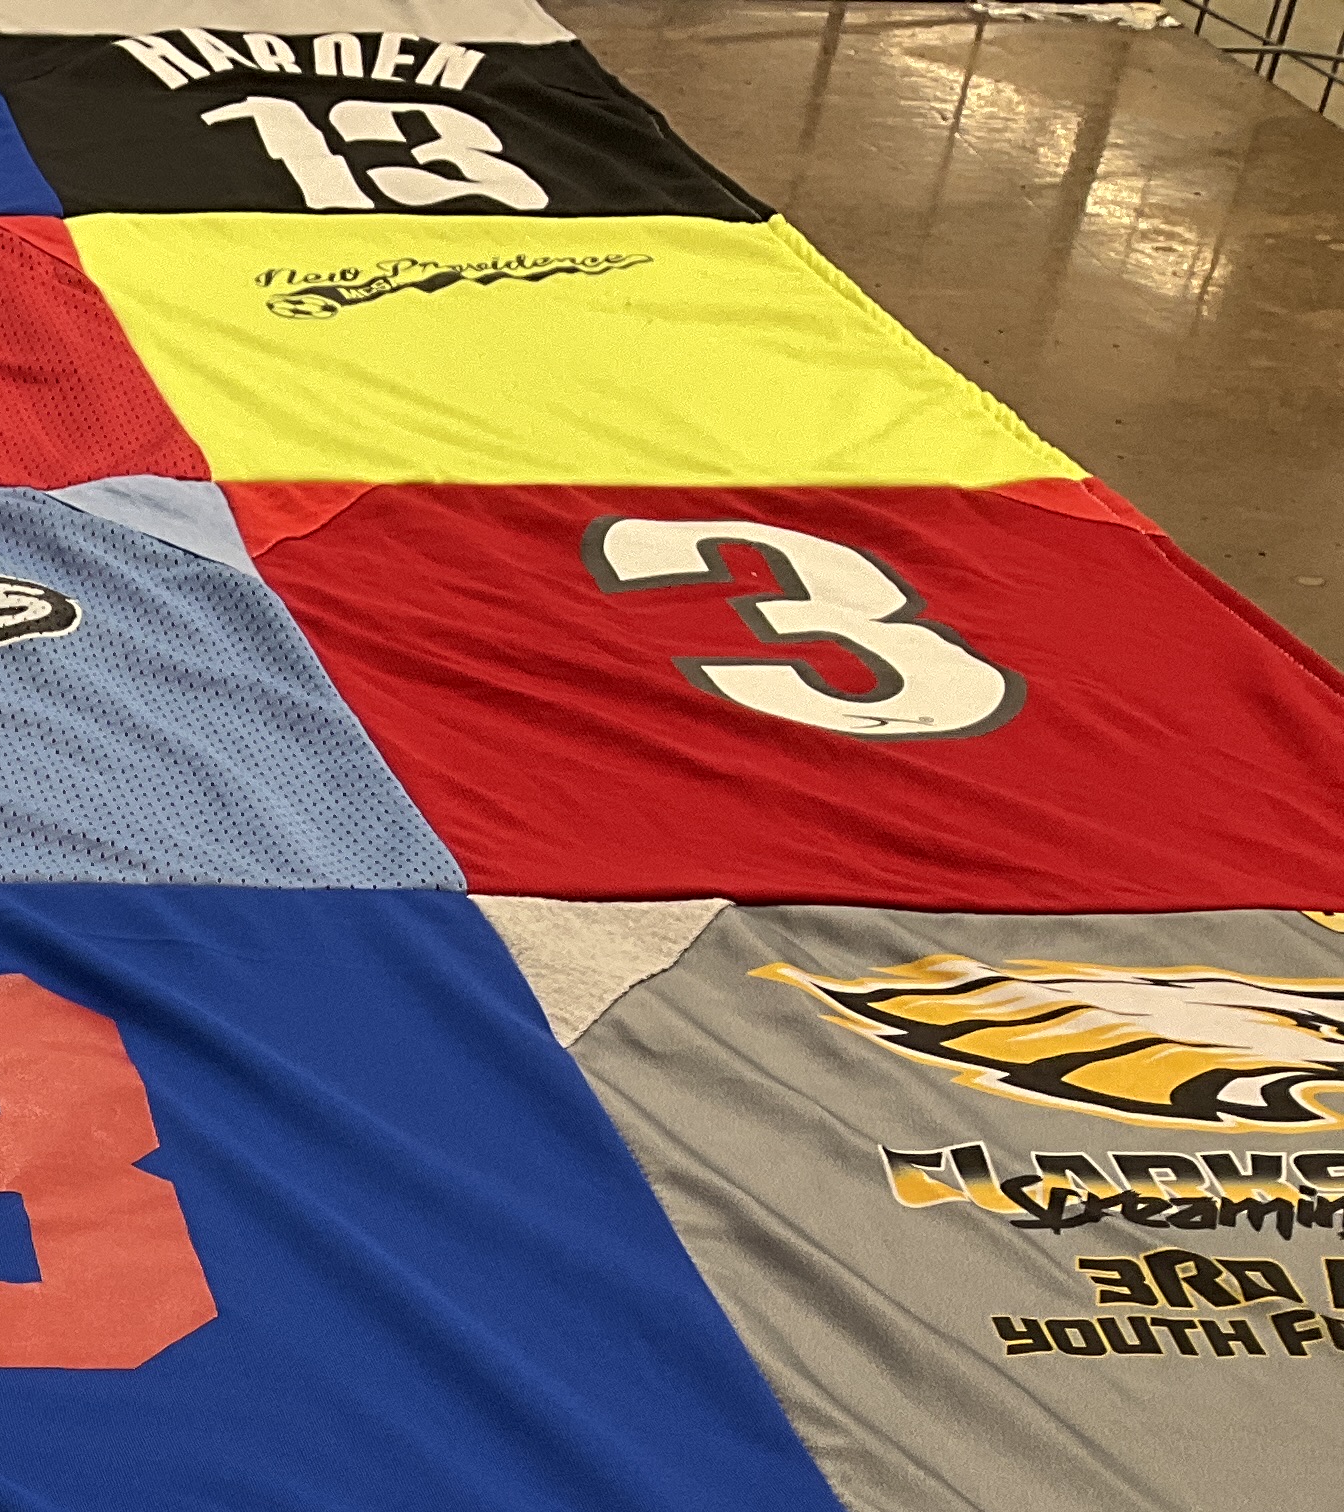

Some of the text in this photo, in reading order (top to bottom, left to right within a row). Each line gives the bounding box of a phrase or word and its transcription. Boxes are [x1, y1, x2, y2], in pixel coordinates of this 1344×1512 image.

[112, 28, 486, 90] HARDEN
[200, 96, 549, 210] 13
[254, 266, 364, 288] New
[580, 514, 1028, 742] 3
[1000, 1174, 1344, 1240] Screamin
[1078, 1247, 1307, 1311] 3RD
[991, 1315, 1269, 1358] YOUTH
